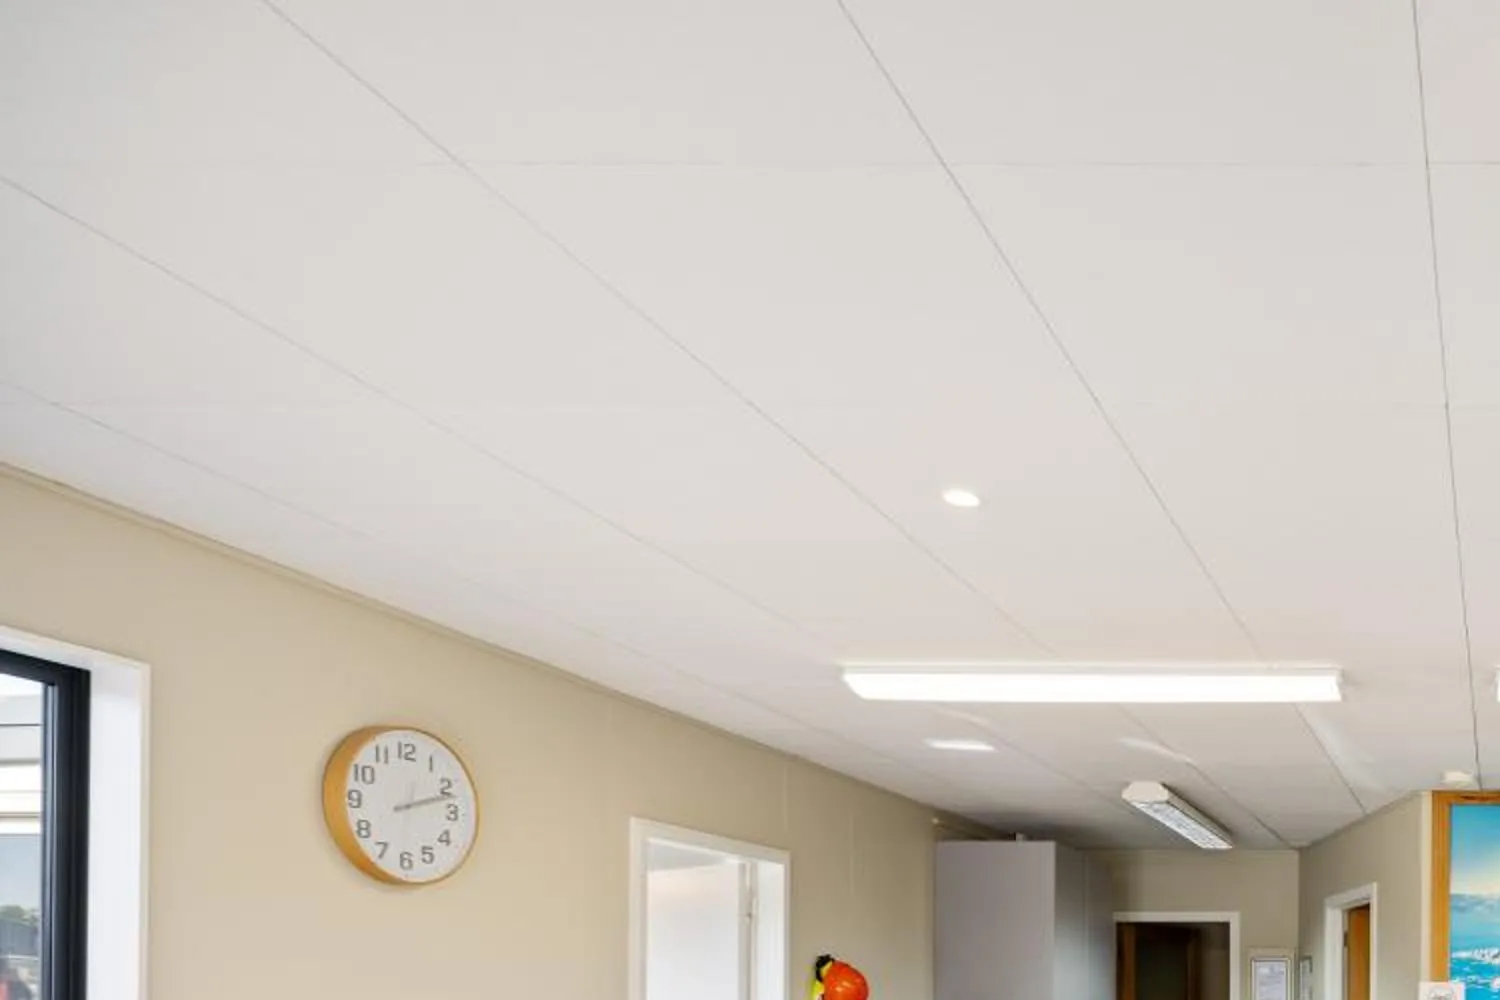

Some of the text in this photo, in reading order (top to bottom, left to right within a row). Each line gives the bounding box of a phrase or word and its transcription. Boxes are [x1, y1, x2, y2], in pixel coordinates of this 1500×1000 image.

[375, 744, 389, 765] 11
[396, 741, 417, 762] 12
[353, 763, 375, 785] 10
[439, 778, 453, 797] 2
[347, 789, 362, 809] 9
[446, 804, 459, 822] 3
[356, 819, 371, 839] 8
[437, 829, 451, 847] 4
[374, 841, 389, 860] 7
[421, 846, 435, 865] 5
[399, 851, 413, 871] 6
